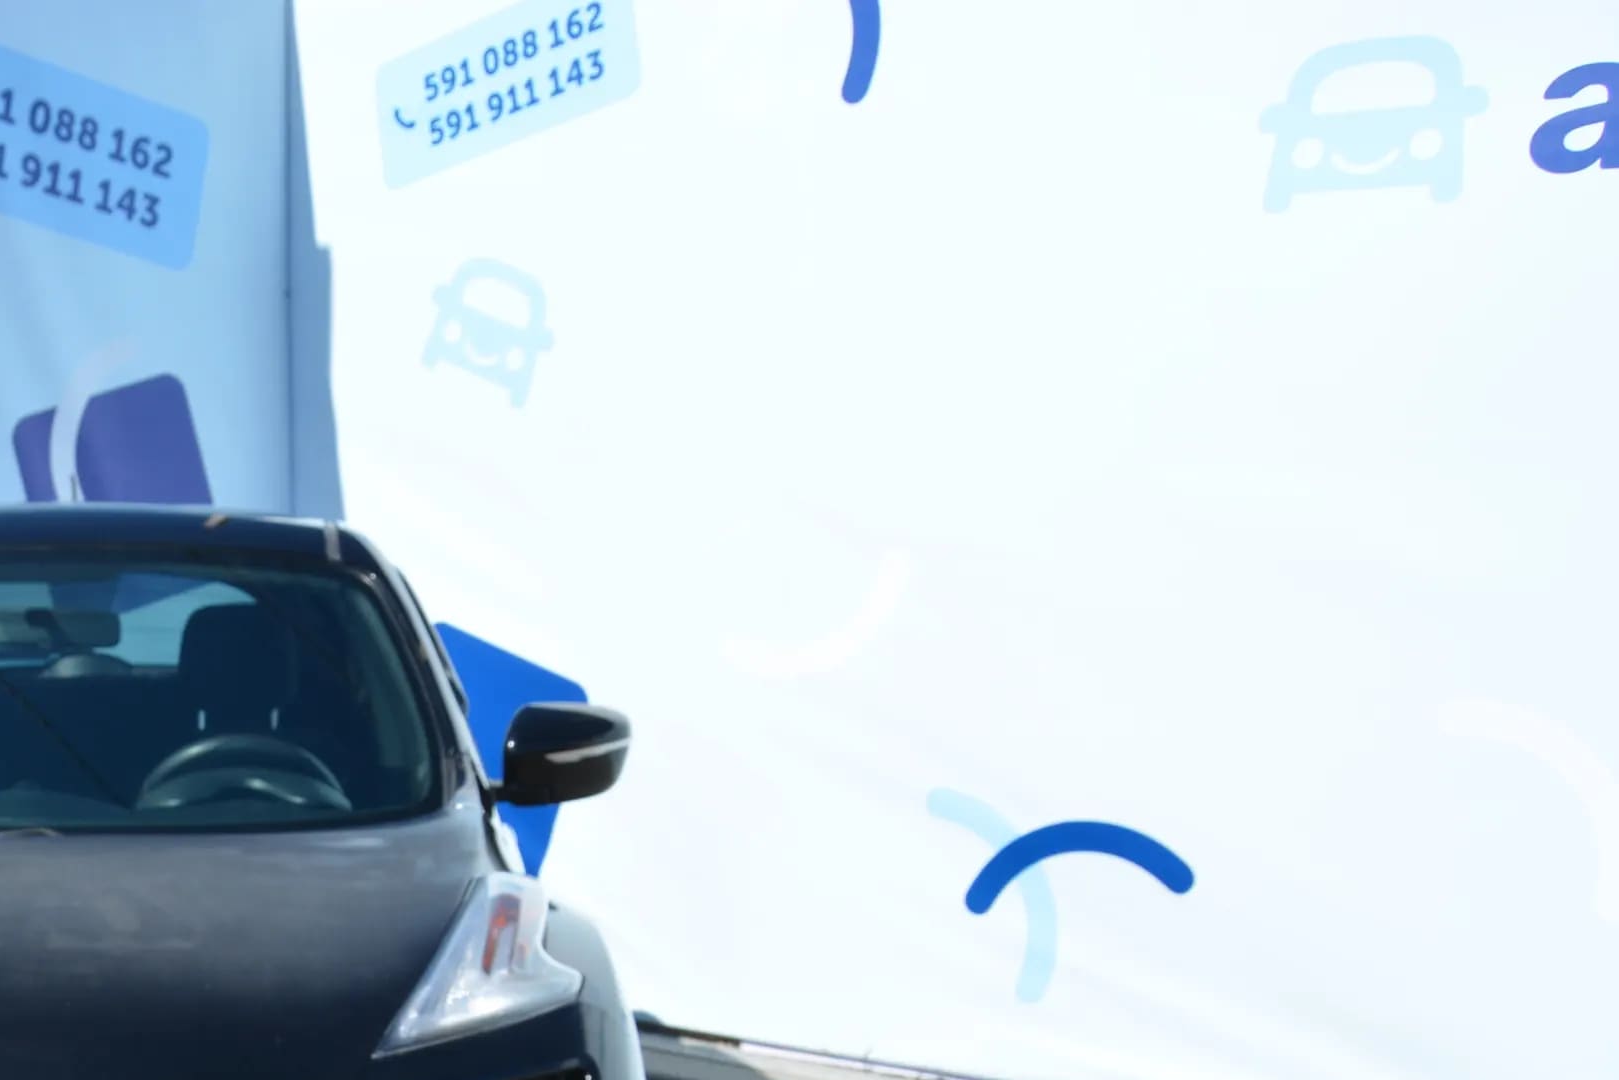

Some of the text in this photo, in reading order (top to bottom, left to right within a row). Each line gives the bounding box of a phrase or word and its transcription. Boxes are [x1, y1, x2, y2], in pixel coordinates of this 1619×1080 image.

[424, 1, 604, 102] 591 088 162
[27, 98, 100, 152] 088
[108, 128, 174, 180] 162
[430, 49, 605, 146] 591 911 143
[19, 153, 85, 206] 911
[93, 179, 161, 230] 143
